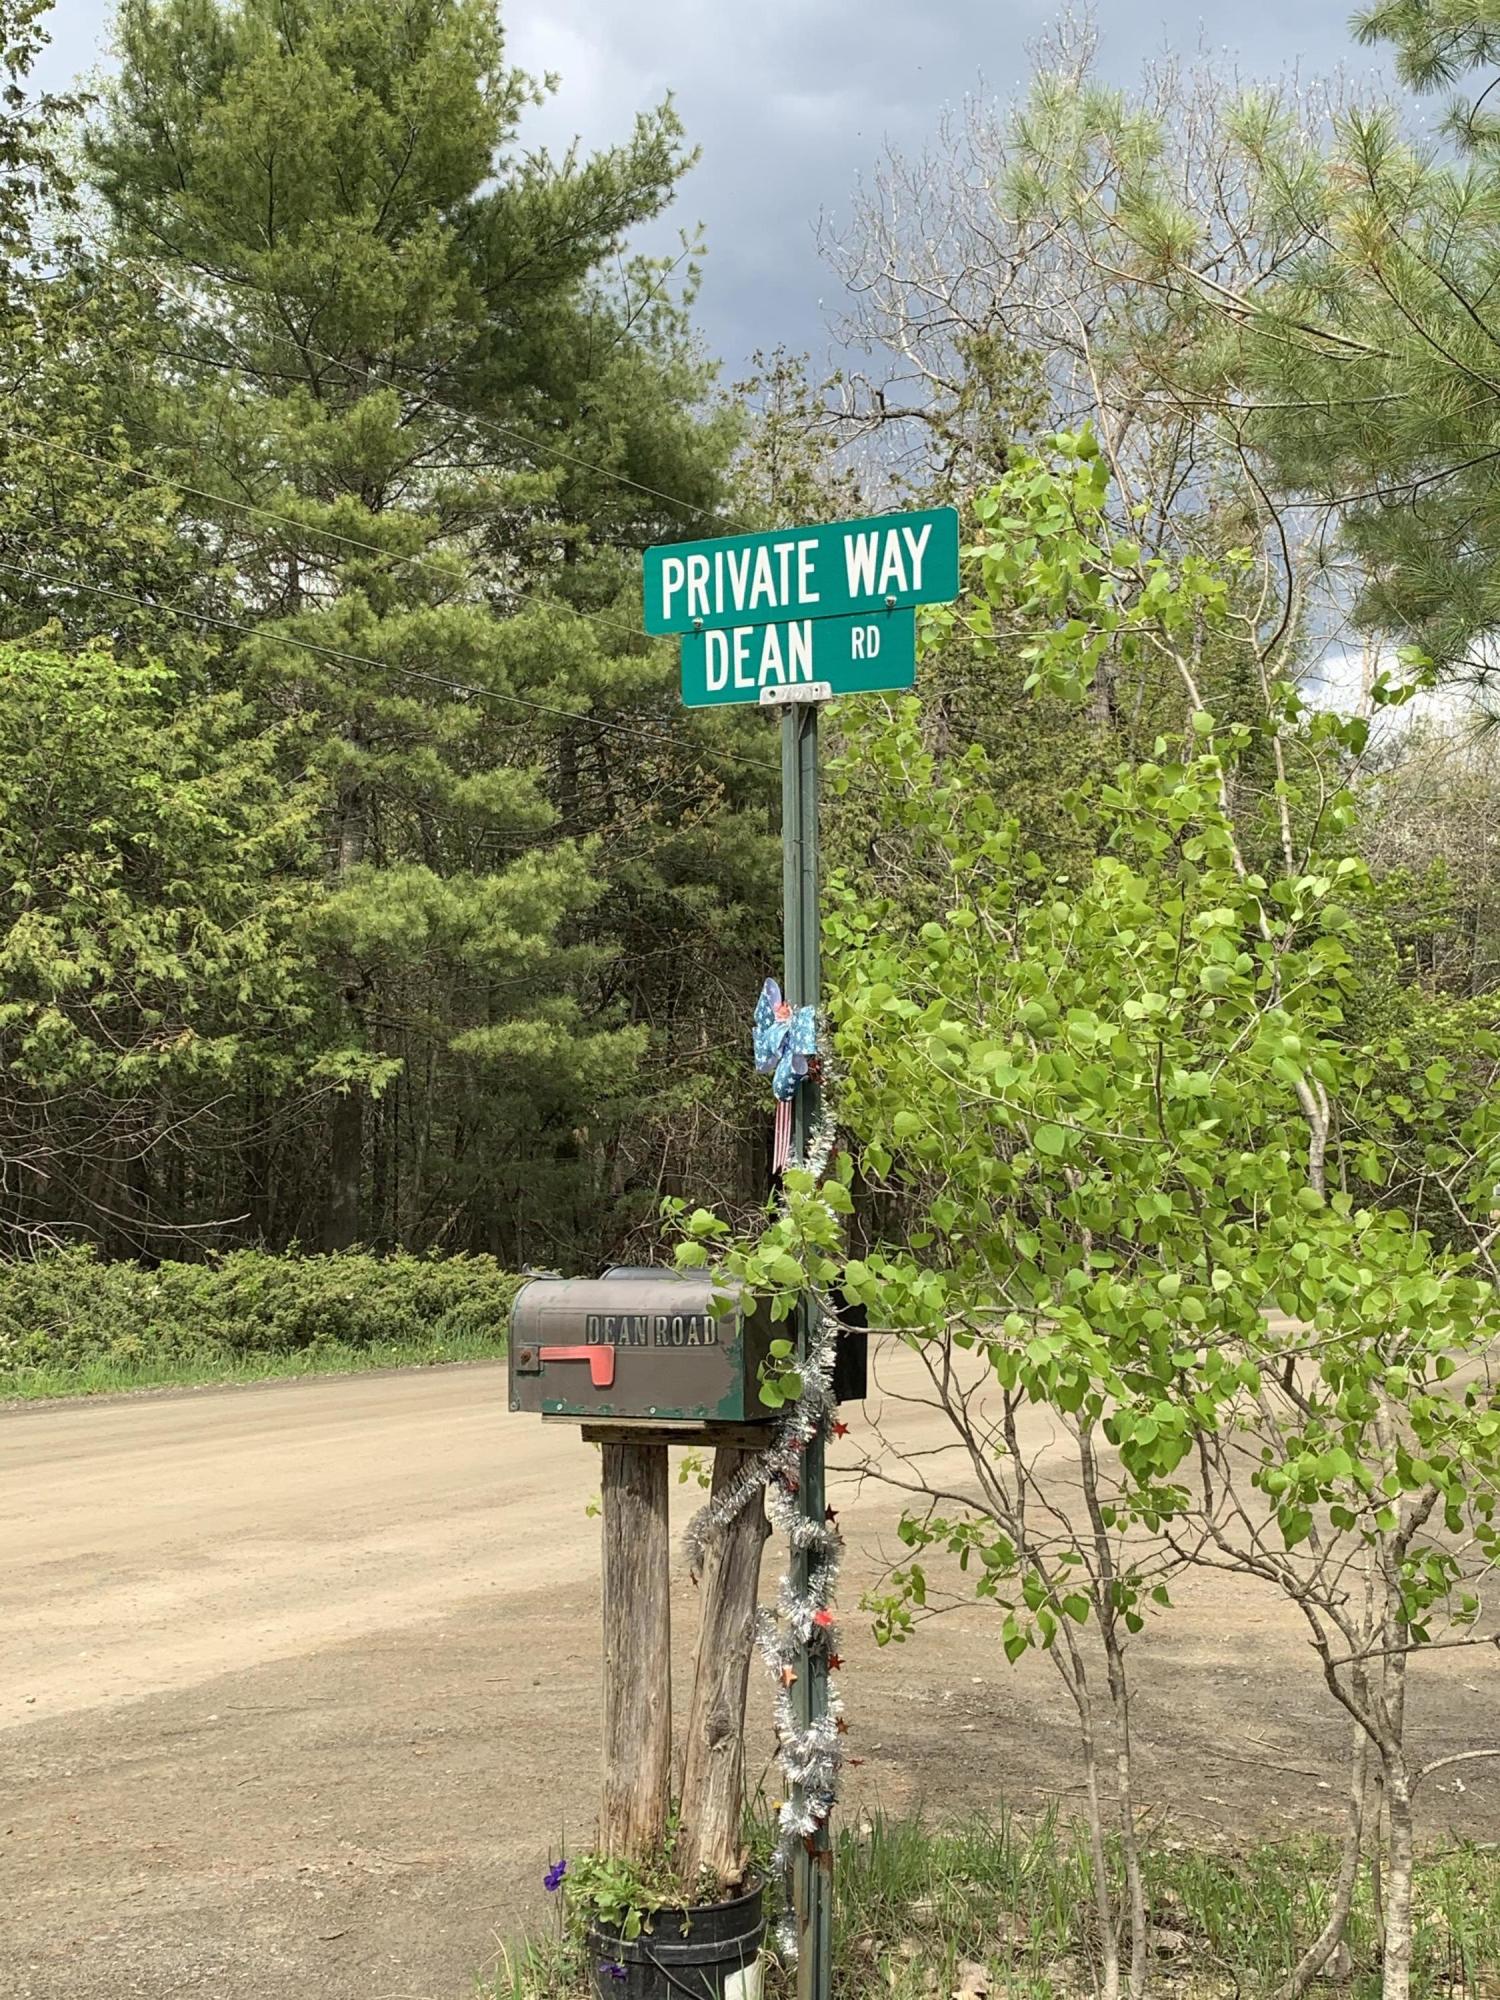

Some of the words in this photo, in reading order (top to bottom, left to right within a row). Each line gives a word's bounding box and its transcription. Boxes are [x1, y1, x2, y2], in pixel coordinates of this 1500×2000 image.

[662, 539, 819, 619] PRIVATE
[844, 524, 933, 598] WAY
[705, 619, 813, 691] DEAN
[851, 625, 880, 659] RD
[588, 1316, 647, 1345] DEAN
[656, 1316, 716, 1345] ROAD
